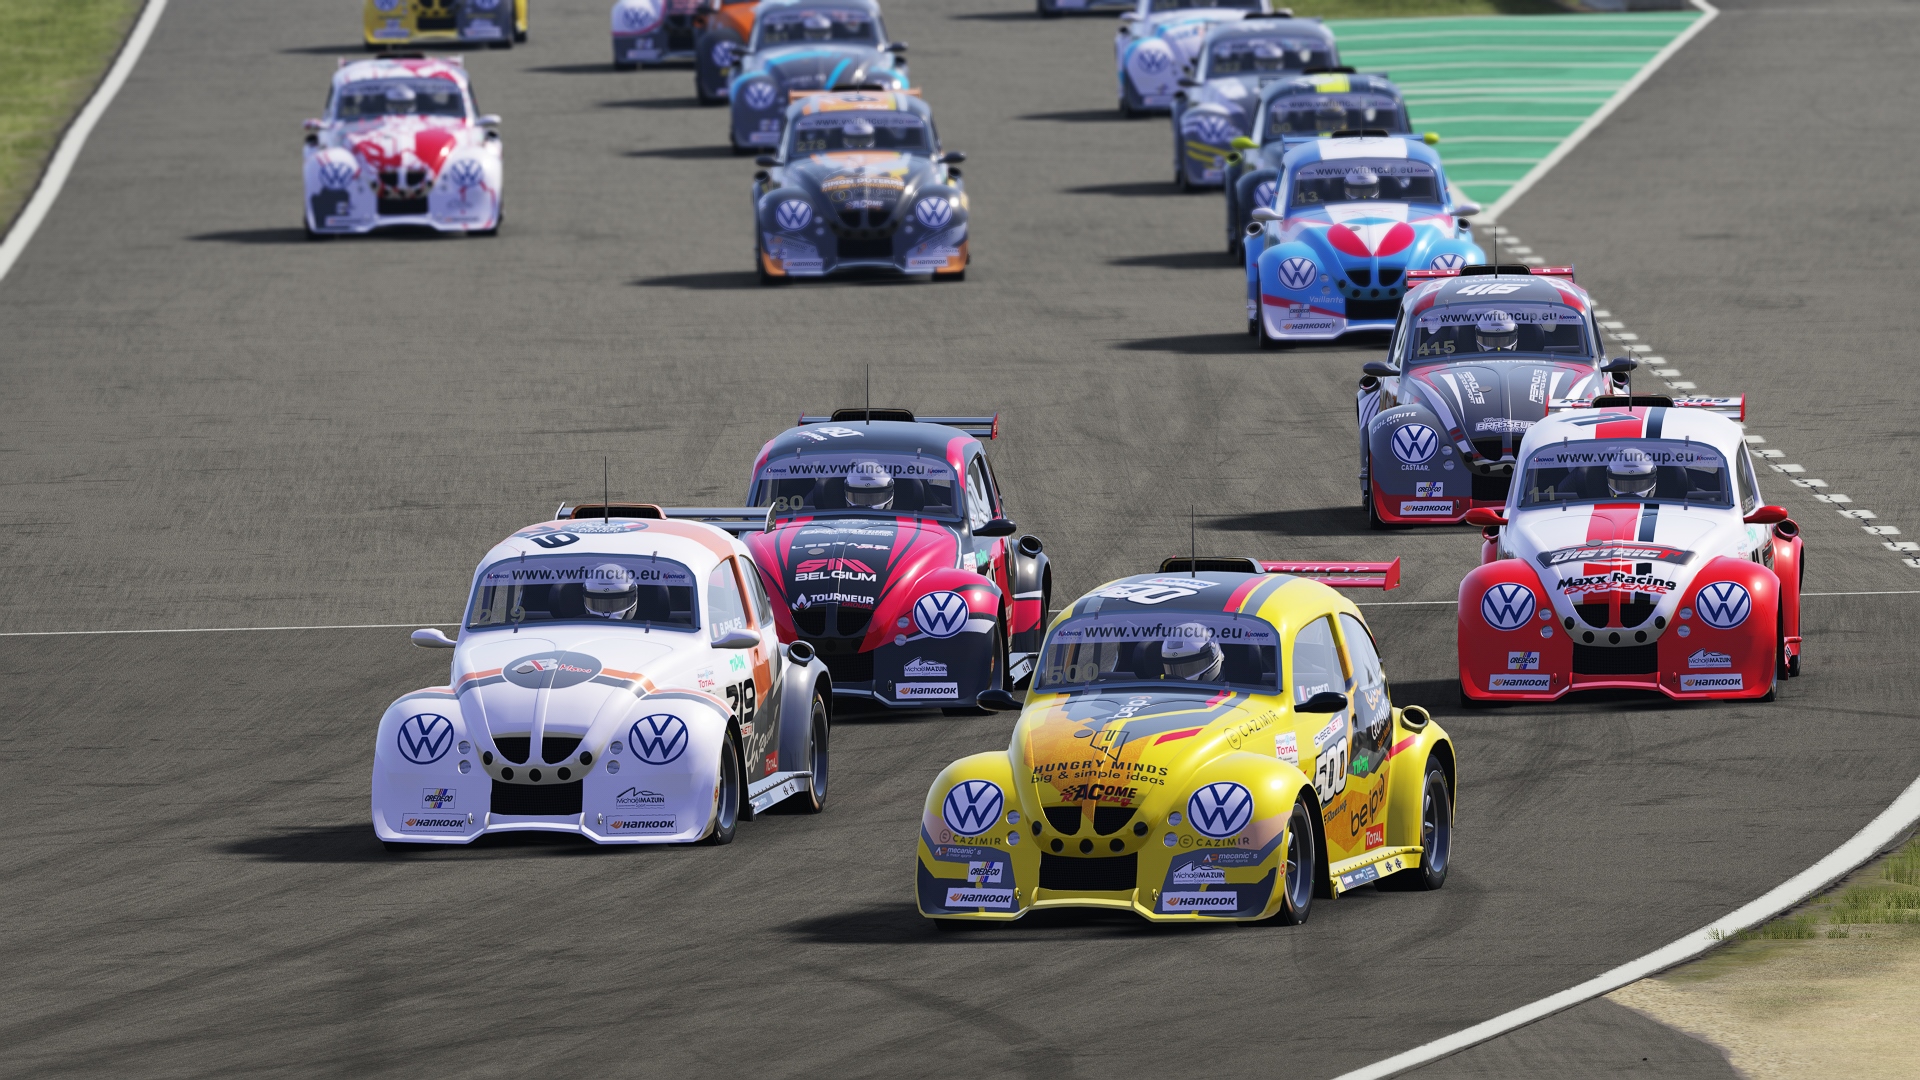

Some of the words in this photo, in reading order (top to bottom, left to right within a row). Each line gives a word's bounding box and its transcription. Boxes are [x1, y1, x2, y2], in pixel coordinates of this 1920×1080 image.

[1456, 284, 1532, 297] 415
[1309, 296, 1344, 304] Vaillante
[1440, 311, 1557, 323] www.vwfuncup.eu
[1417, 340, 1456, 356] 415
[1372, 411, 1417, 434] DOLOMITE
[1556, 450, 1694, 464] www.vwfuncup.eu
[789, 462, 925, 477] www.vwfuncup.eu
[1528, 485, 1555, 503] 11
[1550, 547, 1683, 563] DISTRICT
[512, 566, 661, 583] www.vwfuncup.eu
[795, 570, 877, 582] BELGIUM
[1556, 575, 1608, 590] Maxx
[1612, 572, 1677, 591] Racing
[1564, 581, 1669, 595] EXPERIENCE
[810, 592, 875, 605] TOURNEUR
[1058, 630, 1082, 638] KRONOS
[1085, 622, 1243, 641] www.vwfuncup.eu
[1244, 630, 1270, 639] KRONOS
[1510, 656, 1538, 664] CREDECO
[1051, 662, 1099, 685] 500
[698, 678, 715, 689] TOTAL
[1238, 710, 1279, 737] CAZIMIR
[1277, 745, 1298, 755] TOTAL
[1033, 759, 1106, 774] HUNGRY
[1111, 760, 1169, 776] MINDS
[1315, 734, 1349, 807] 500
[1031, 771, 1053, 784] big
[1057, 770, 1069, 780] &
[1074, 768, 1121, 780] simple
[1126, 771, 1165, 786] ideas
[424, 794, 454, 803] CREDECO
[952, 835, 1002, 845] CAZIMIR
[1196, 836, 1250, 847] CAZIMIR
[1366, 828, 1383, 848] TOTAL
[970, 867, 1001, 876] CREDECO
